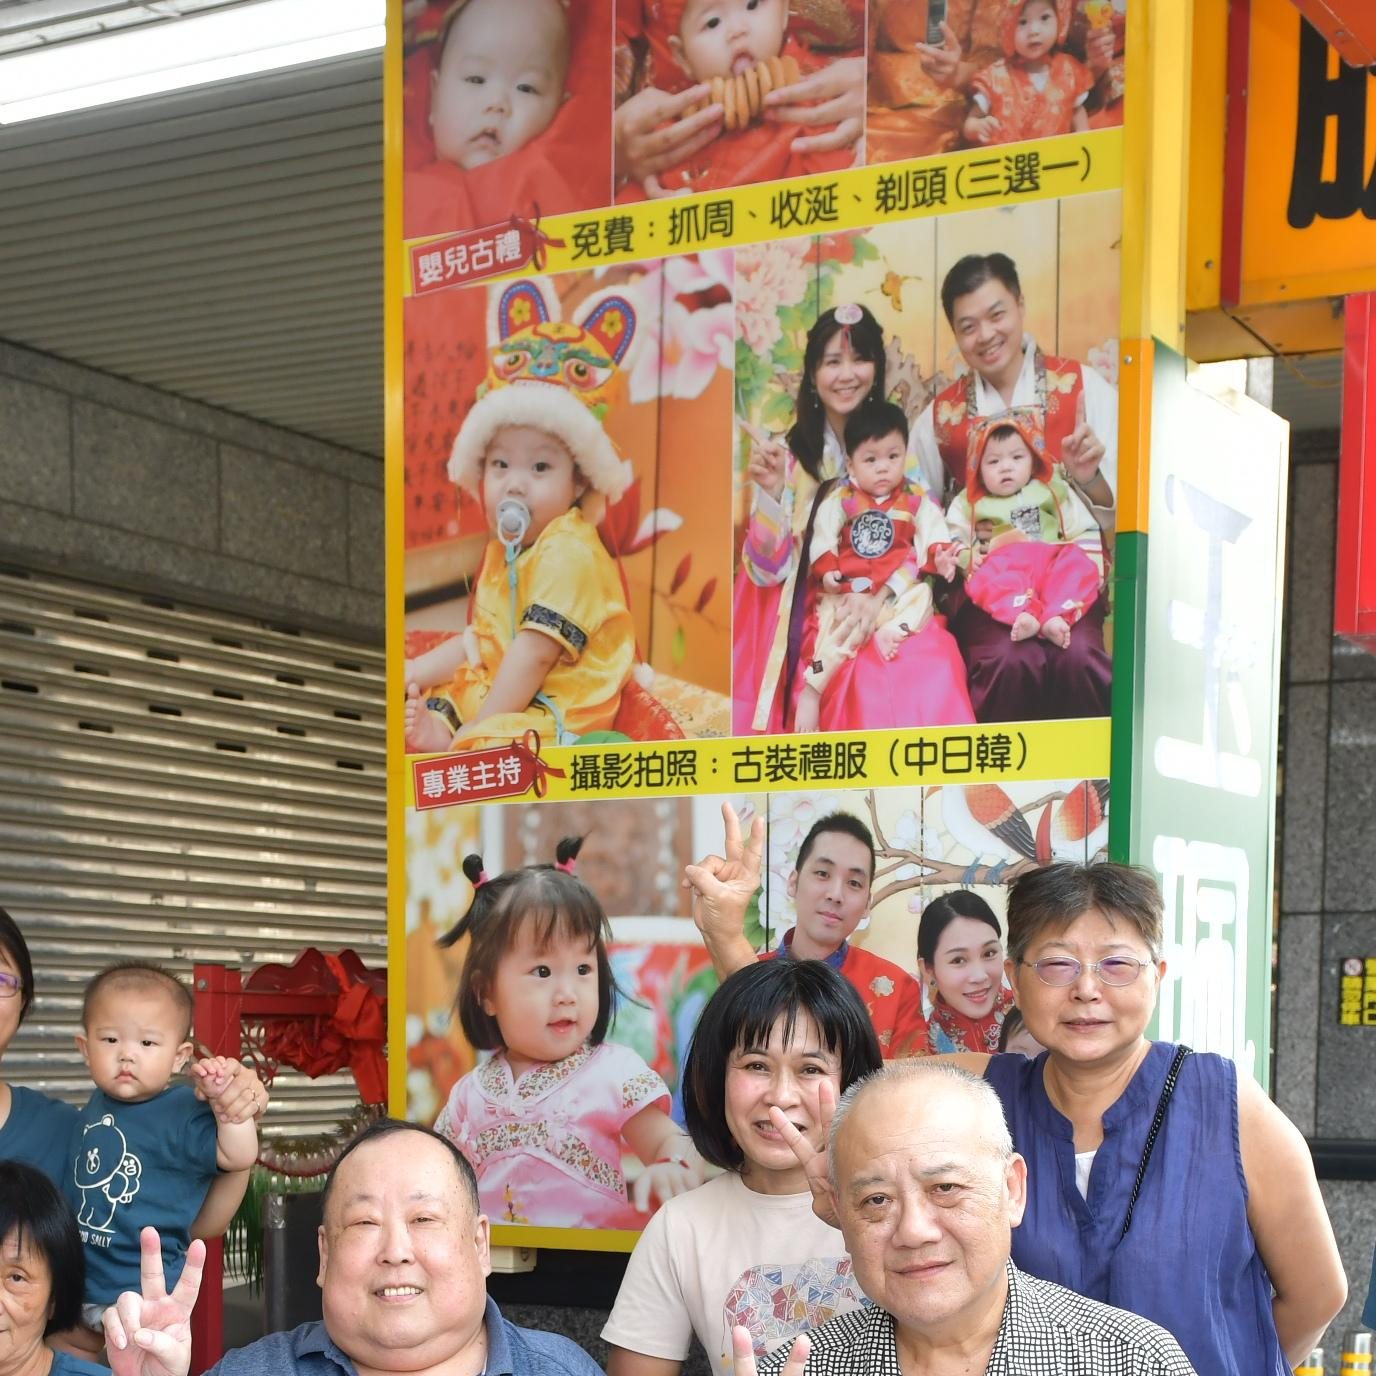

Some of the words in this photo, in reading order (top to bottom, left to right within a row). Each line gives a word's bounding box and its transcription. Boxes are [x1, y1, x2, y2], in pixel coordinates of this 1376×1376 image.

[417, 229, 523, 290] 嬰兒古禮
[420, 755, 523, 799] 專業主持
[91, 1233, 112, 1249] SALLY
